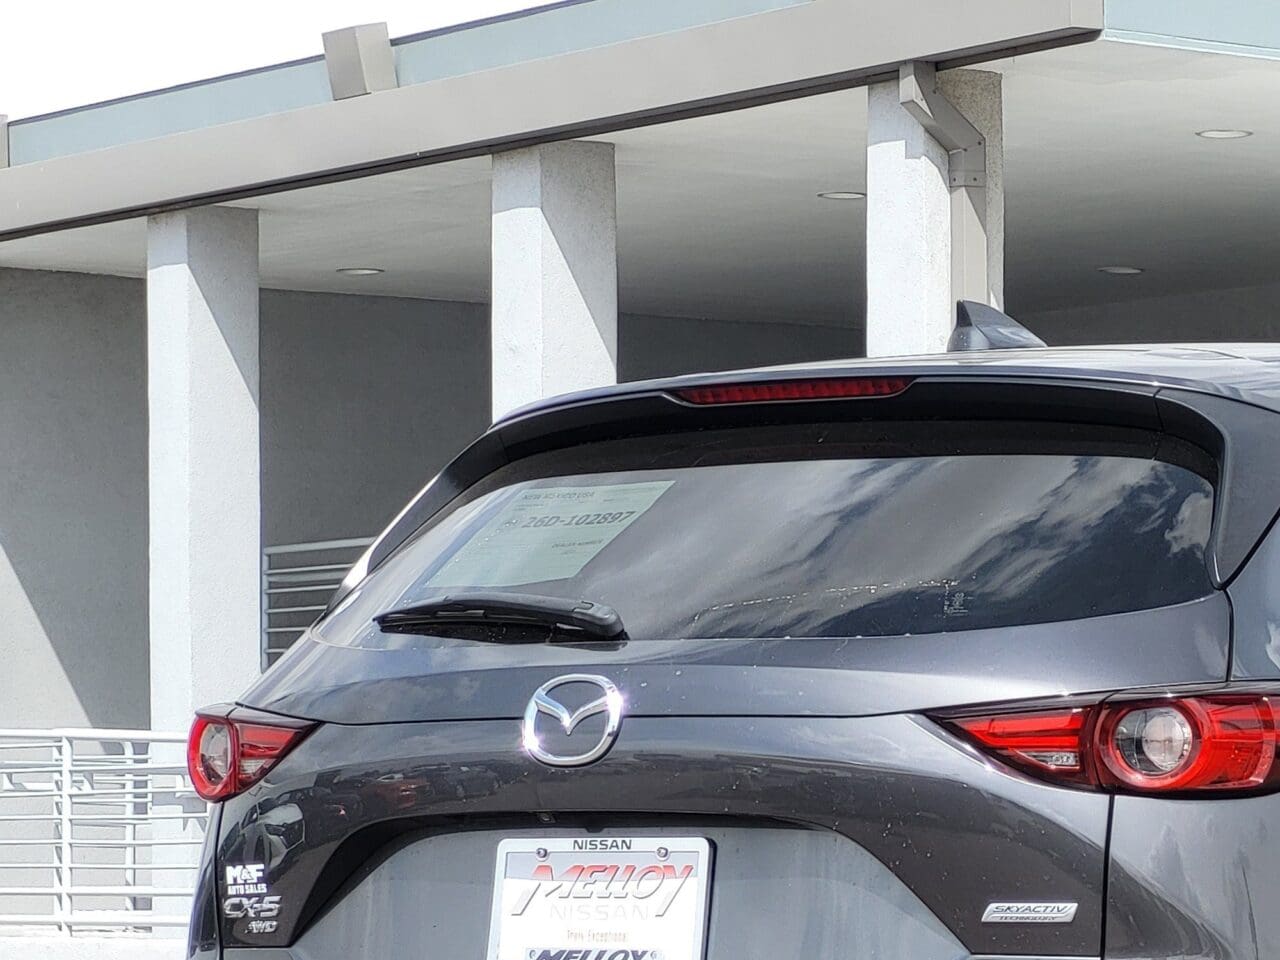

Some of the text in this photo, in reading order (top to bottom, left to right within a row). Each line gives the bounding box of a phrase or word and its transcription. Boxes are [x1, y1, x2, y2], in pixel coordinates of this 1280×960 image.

[521, 510, 637, 528] 26D-102897
[573, 839, 632, 851] NISSAN
[225, 864, 265, 884] M&F
[227, 883, 268, 895] AUTO SALES
[511, 864, 694, 917] MELLOY
[224, 896, 282, 918] CX-5
[993, 905, 1068, 913] SKYACTIV
